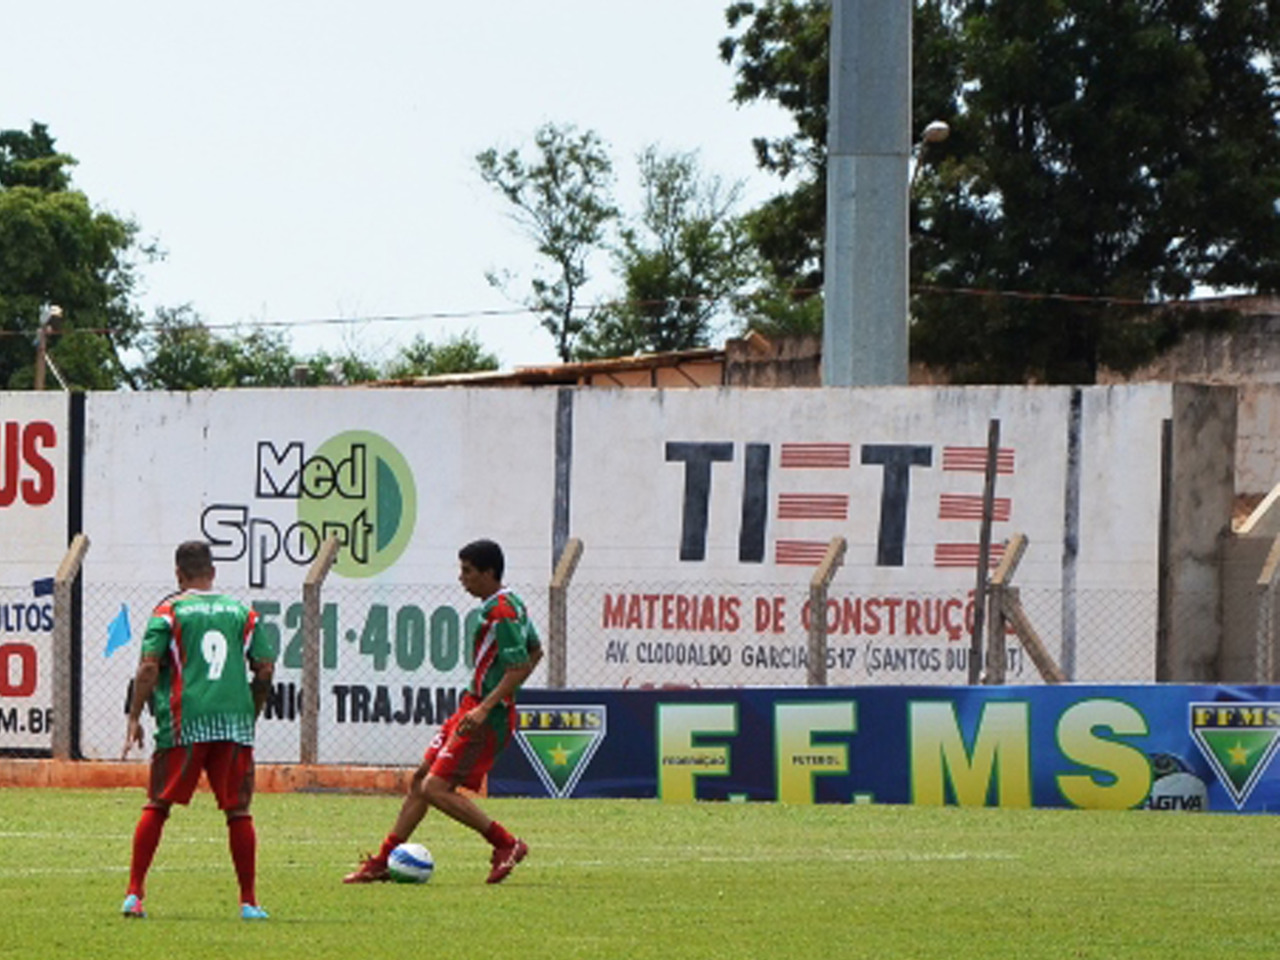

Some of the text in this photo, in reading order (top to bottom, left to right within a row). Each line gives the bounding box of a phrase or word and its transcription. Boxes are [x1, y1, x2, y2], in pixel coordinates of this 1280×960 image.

[255, 441, 366, 499] Med
[664, 441, 1015, 567] TIETE
[602, 593, 741, 633] MATERIAIS
[755, 596, 786, 634] DE
[201, 630, 228, 681] 9
[741, 645, 809, 669] GARCIA
[332, 684, 469, 726] TRAJAN
[520, 711, 602, 729] FFMS
[1194, 707, 1280, 727] FFMS
